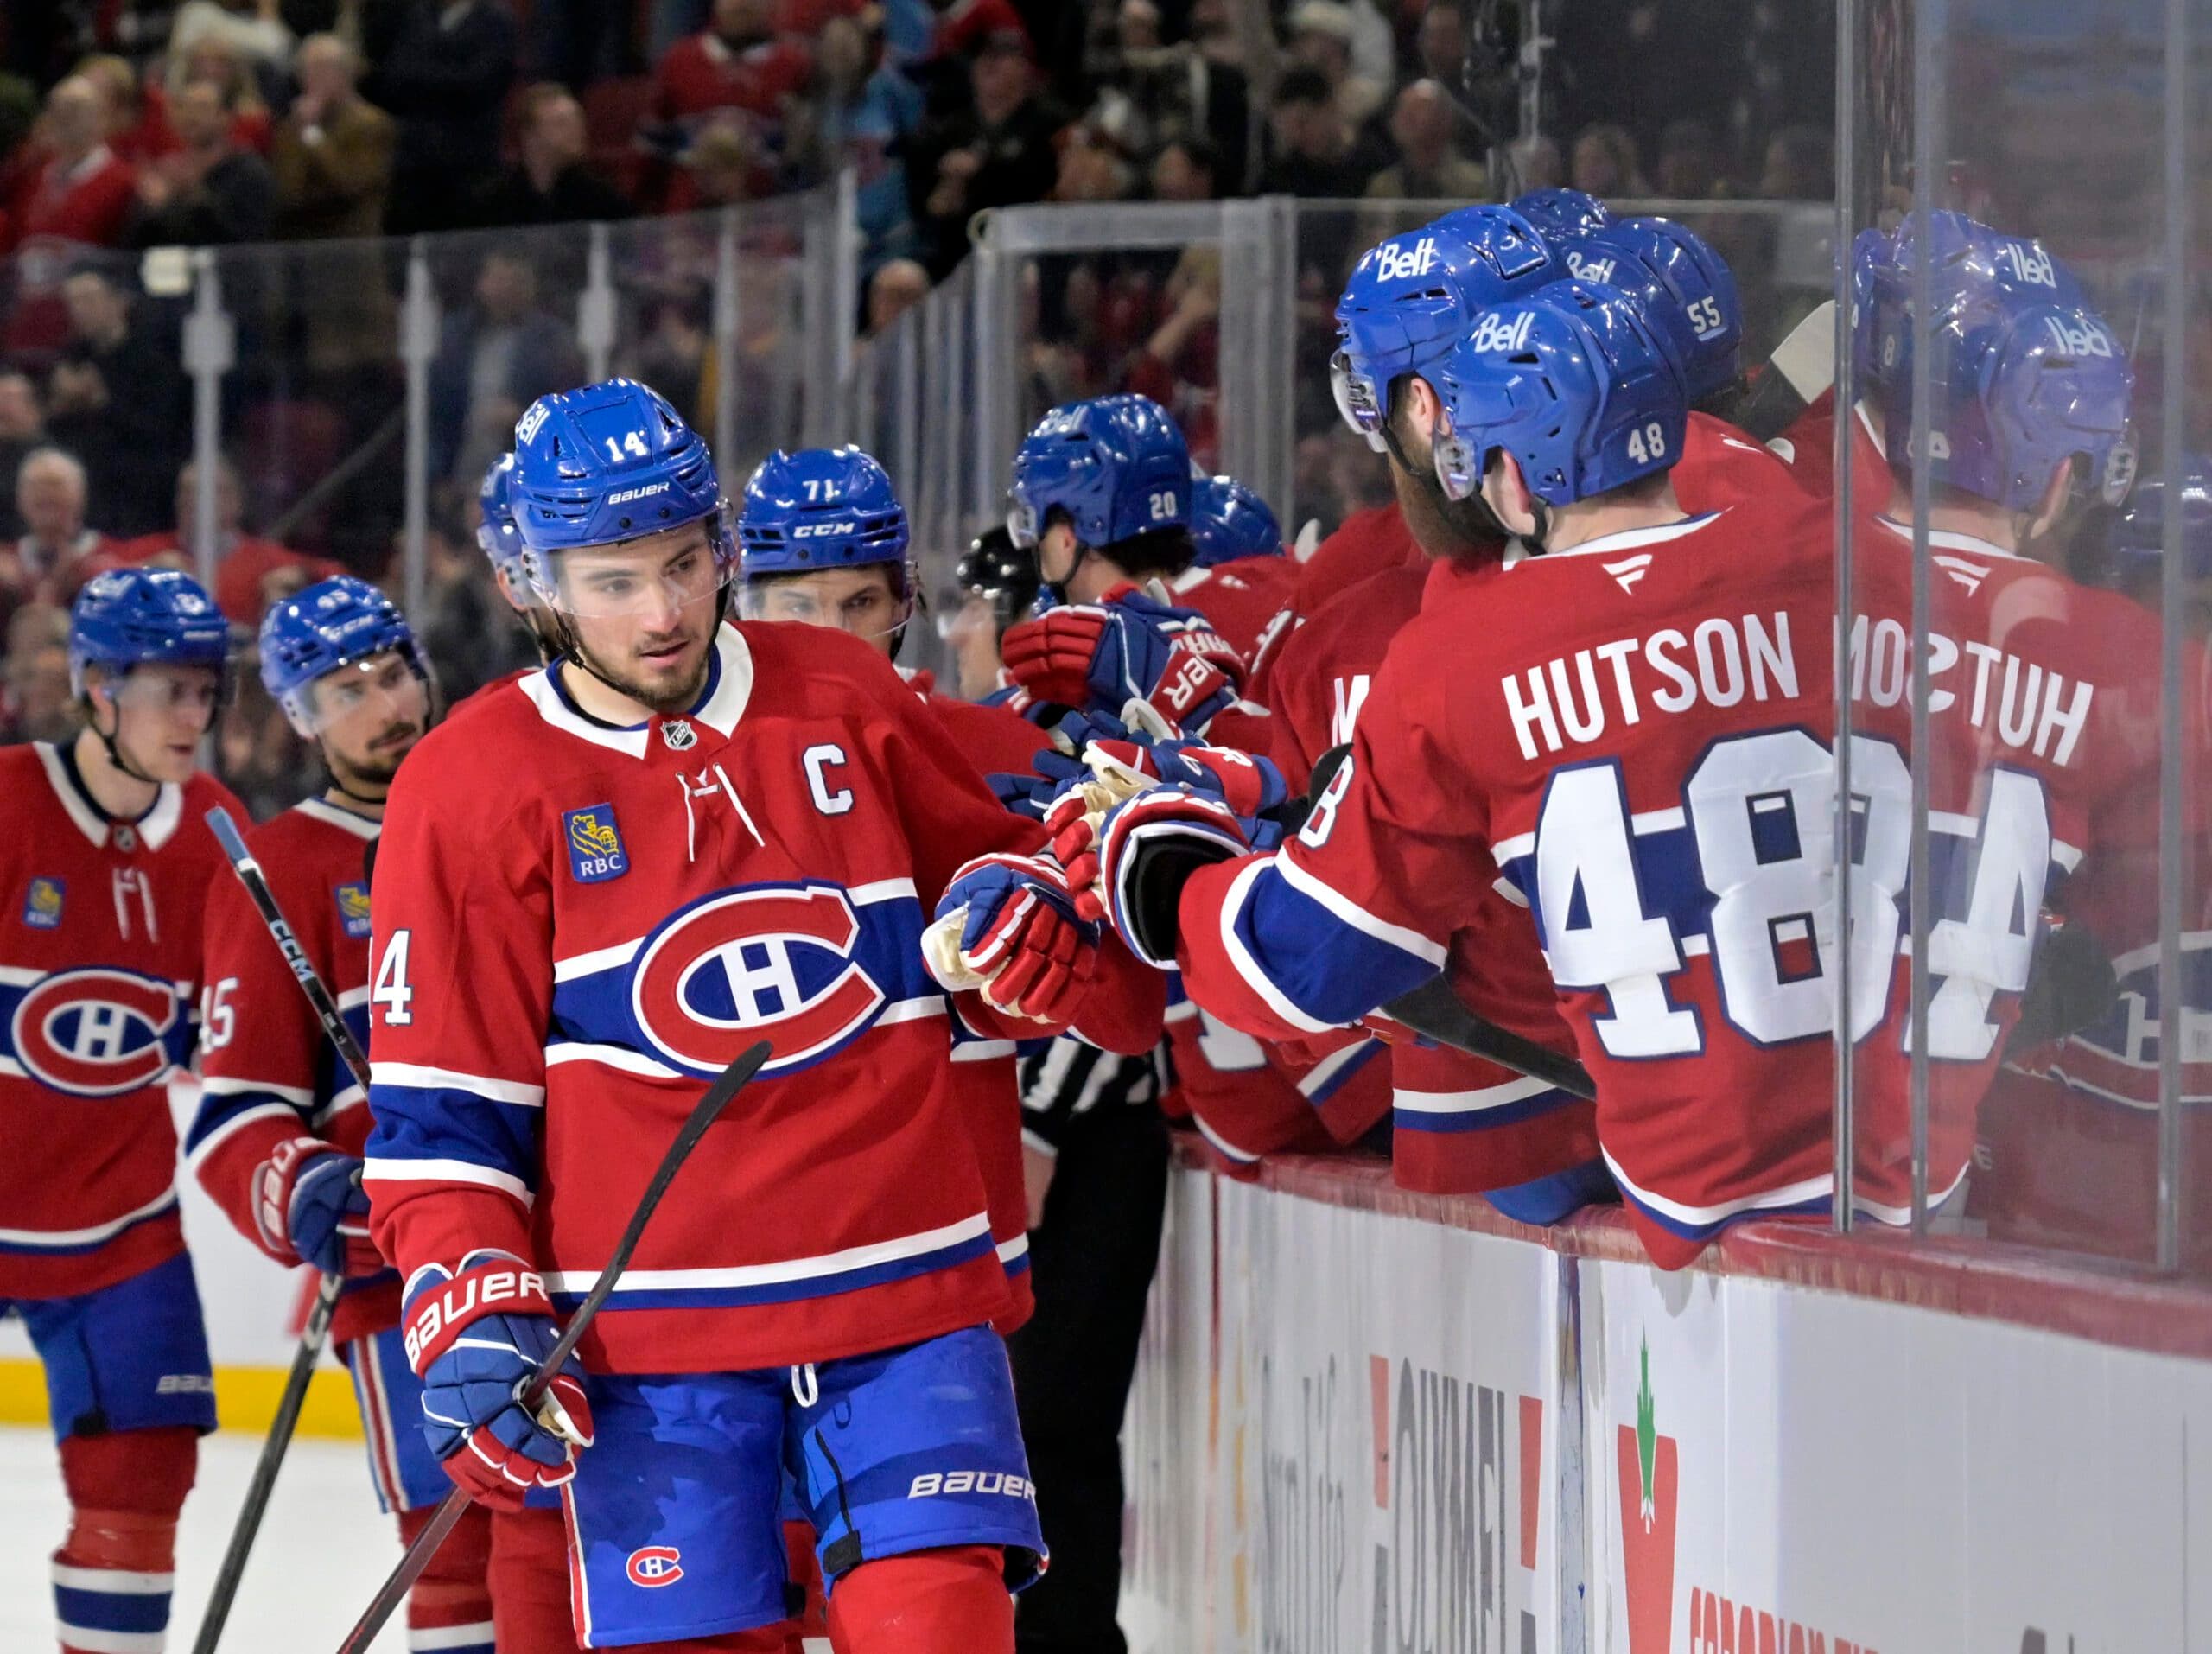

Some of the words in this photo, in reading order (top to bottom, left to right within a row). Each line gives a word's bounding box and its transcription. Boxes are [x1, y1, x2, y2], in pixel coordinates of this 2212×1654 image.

[1377, 237, 1434, 283] Bell
[1474, 312, 1535, 353] Bell
[1687, 296, 1721, 334] 55
[606, 431, 647, 462] 14
[1628, 423, 1665, 464] 48
[802, 478, 834, 503] 71
[1149, 491, 1177, 520] 20
[793, 522, 855, 538] CCM
[1501, 611, 1799, 760] HUTSON
[802, 743, 854, 815] C
[580, 854, 622, 877] RBC
[1537, 730, 1834, 1058] 48
[270, 919, 316, 983] CCM
[368, 929, 413, 1026] 4
